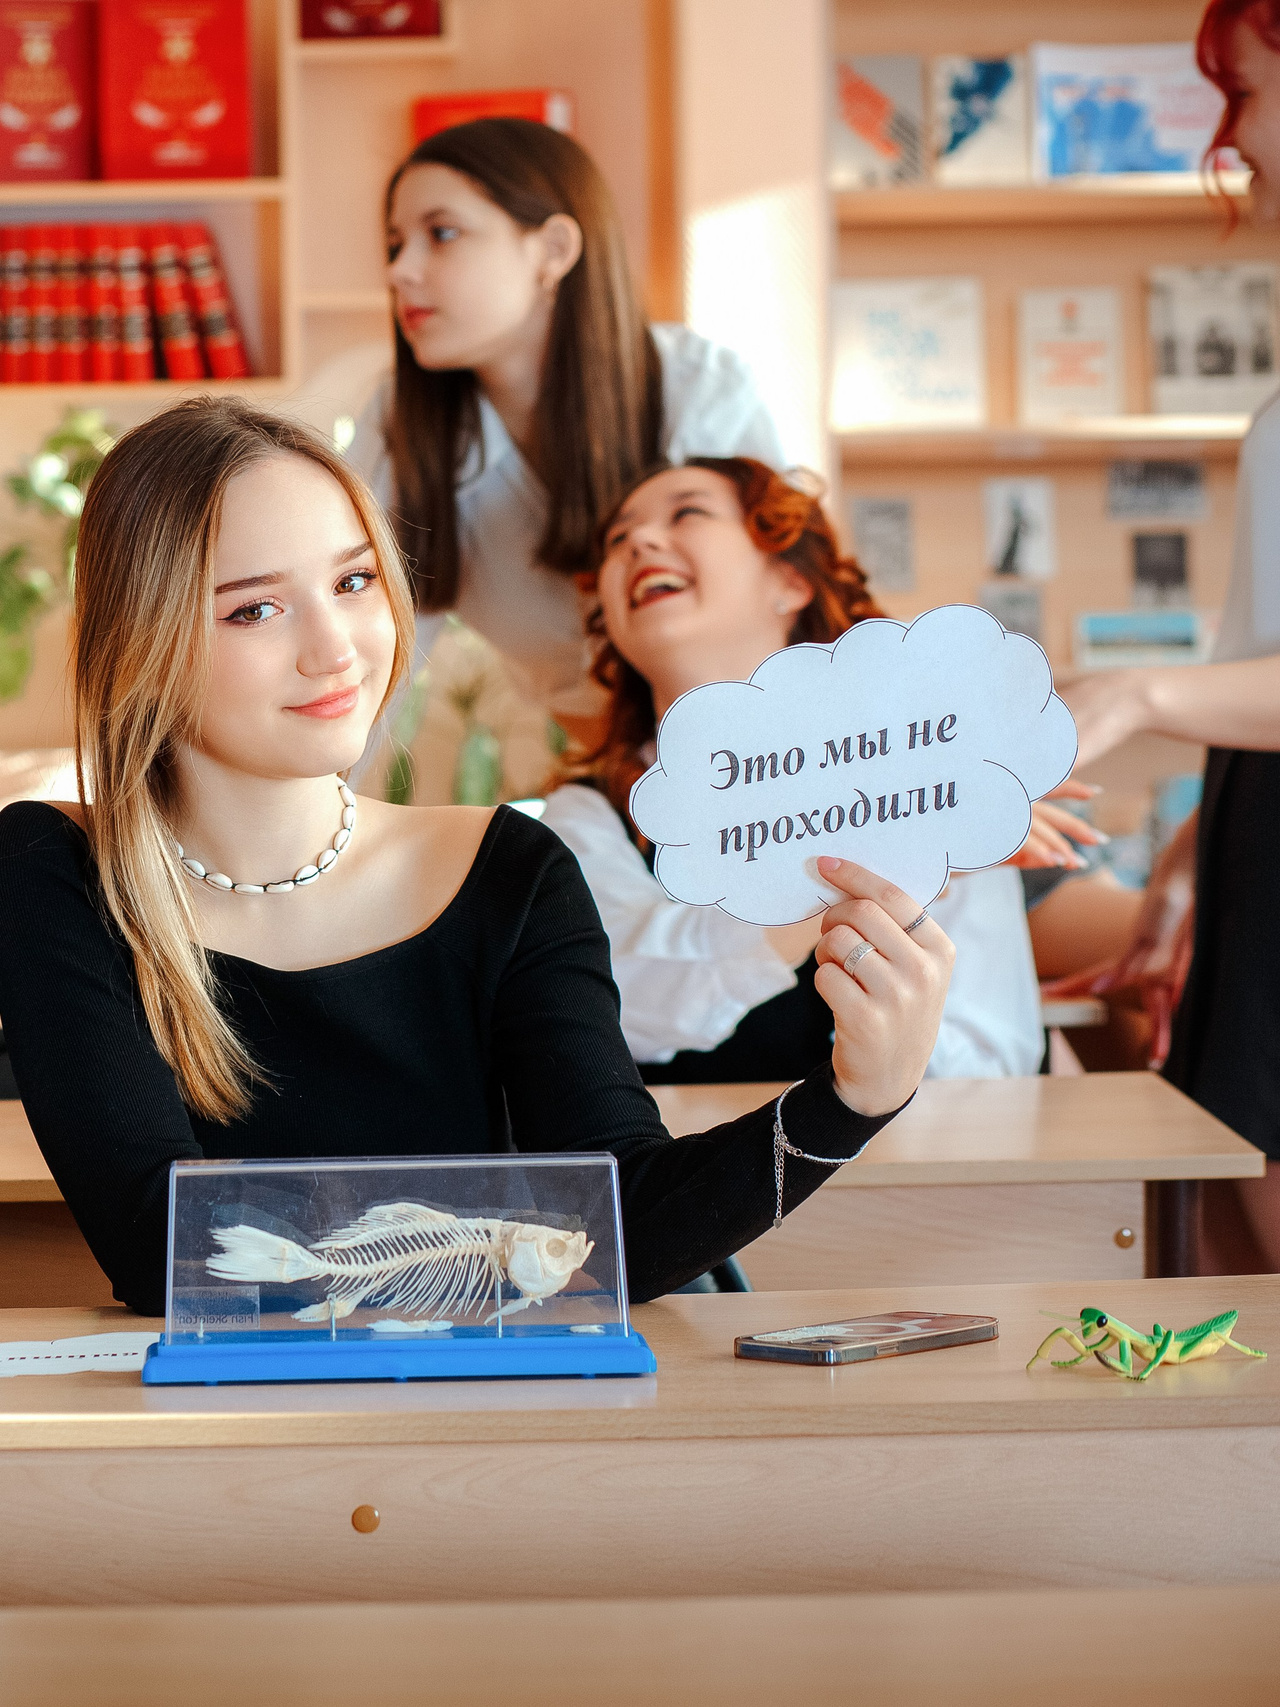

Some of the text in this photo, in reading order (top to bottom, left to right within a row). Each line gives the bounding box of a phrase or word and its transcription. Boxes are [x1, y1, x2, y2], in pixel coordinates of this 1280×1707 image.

[709, 713, 959, 791] Это мы не
[718, 778, 959, 862] проходили
